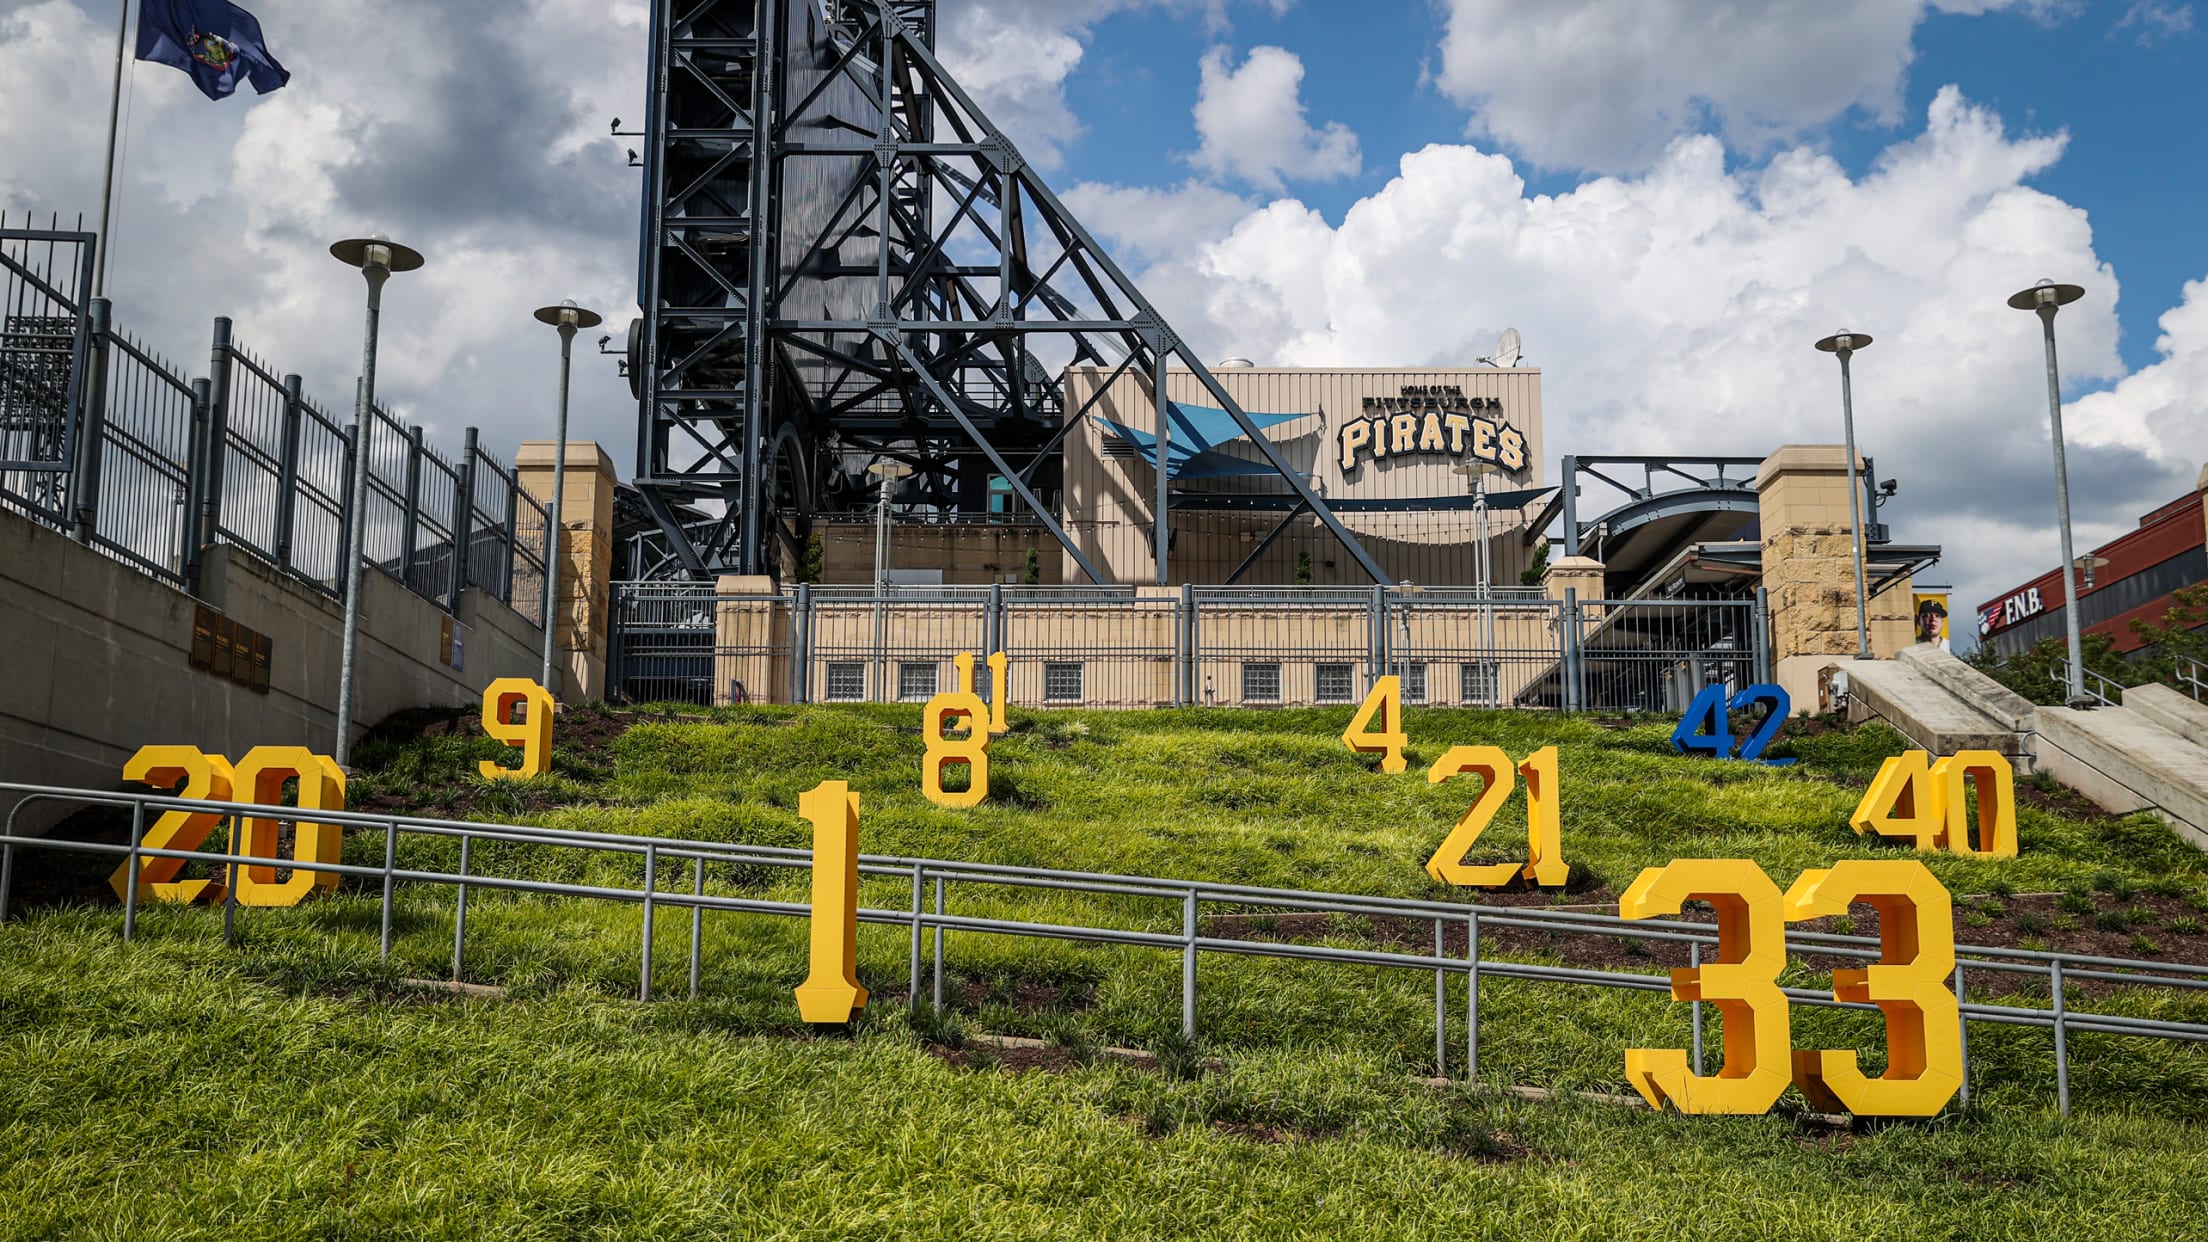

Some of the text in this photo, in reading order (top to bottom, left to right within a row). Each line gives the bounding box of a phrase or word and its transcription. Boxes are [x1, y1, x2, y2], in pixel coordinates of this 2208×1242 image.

[1362, 397, 1500, 409] PITTSBURGH
[1400, 385, 1461, 395] HOME OF THE
[1337, 411, 1528, 474] PIRATES
[479, 677, 554, 780] 9
[954, 652, 1010, 733] 11
[1342, 675, 1408, 774] 4
[1670, 684, 1796, 767] 42
[922, 693, 990, 808] 8
[108, 745, 347, 907] 20
[1425, 746, 1570, 887] 21
[1849, 750, 2018, 858] 40
[794, 780, 869, 1023] 1
[1619, 859, 1962, 1116] 33
